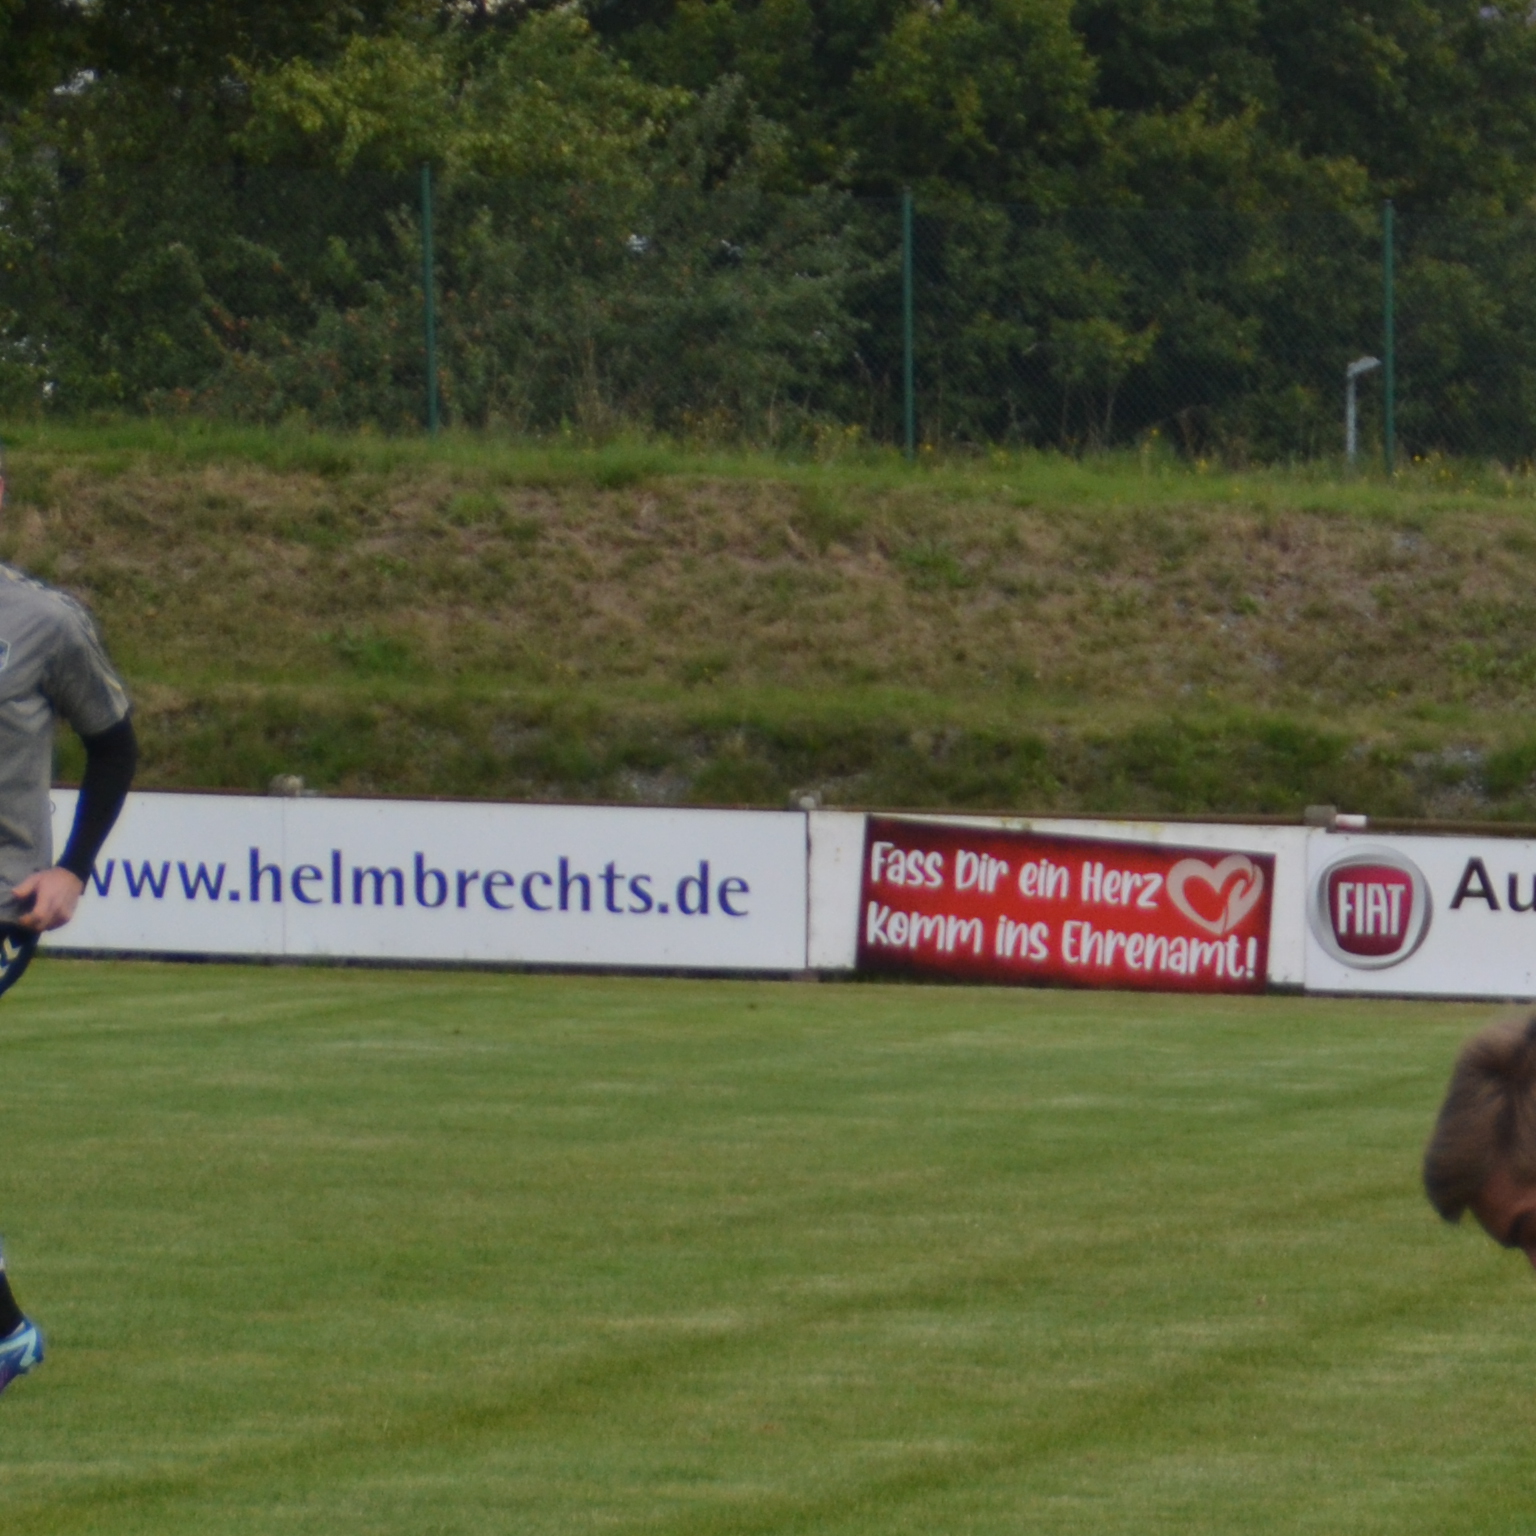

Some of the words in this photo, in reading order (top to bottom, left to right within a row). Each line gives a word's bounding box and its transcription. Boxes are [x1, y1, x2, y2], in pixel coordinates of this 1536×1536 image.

[871, 840, 944, 888] Fass
[955, 848, 1008, 893] Dir
[1018, 859, 1069, 899] ein
[1081, 861, 1165, 908] Herz
[866, 901, 983, 954] Komm
[996, 915, 1049, 960] ins
[1061, 920, 1258, 979] Ehrenamt!
[1337, 881, 1406, 938] FIAT
